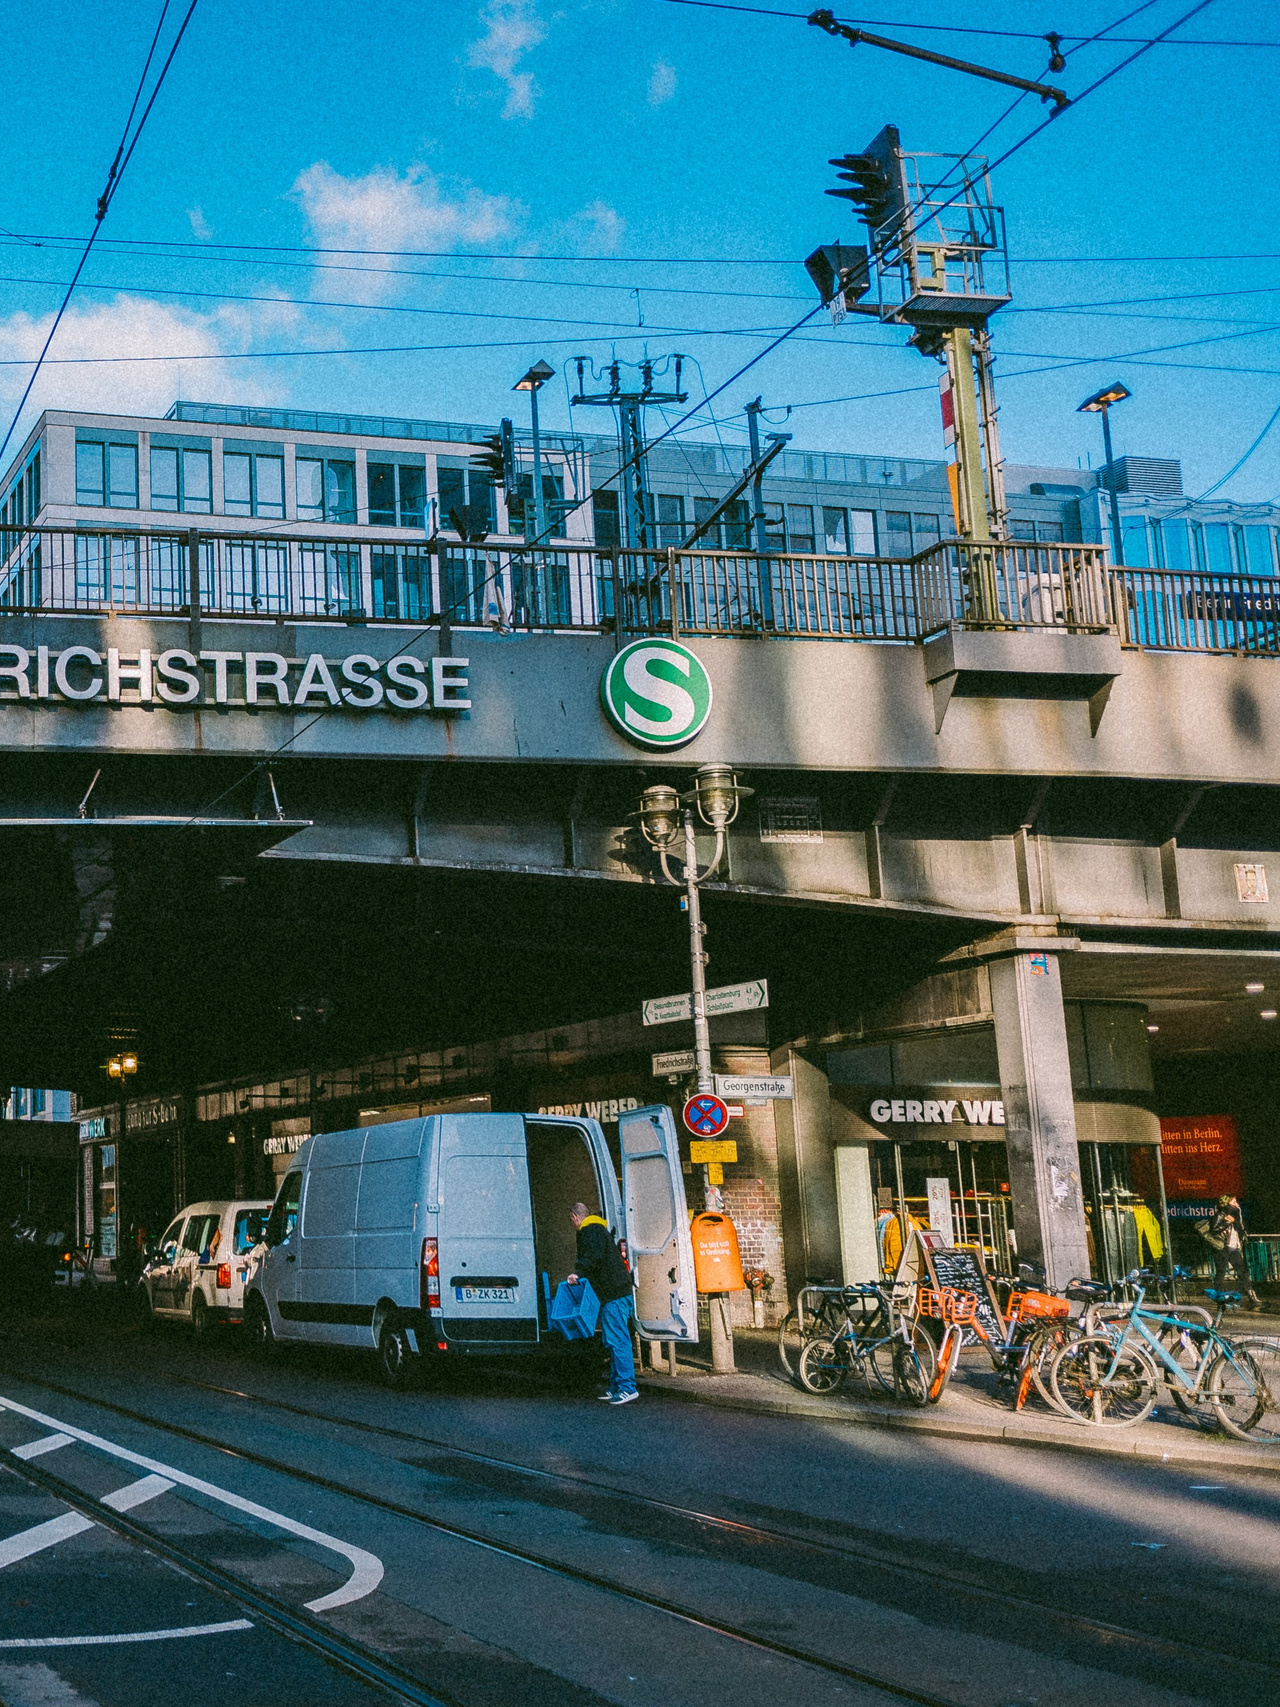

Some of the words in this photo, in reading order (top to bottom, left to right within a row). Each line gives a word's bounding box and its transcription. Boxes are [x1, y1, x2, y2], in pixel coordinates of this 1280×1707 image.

[623, 647, 696, 736] S
[706, 989, 741, 1002] Charlottenburg
[656, 1053, 695, 1069] Friedrichstraße
[723, 1079, 786, 1094] Georgenstraße
[870, 1099, 957, 1123] GERRY
[1162, 1129, 1181, 1140] itten
[1183, 1130, 1192, 1139] in
[1194, 1127, 1223, 1139] Berlin.
[263, 1136, 286, 1155] GERRY
[1161, 1143, 1183, 1154] itten
[1185, 1143, 1198, 1153] ins
[1200, 1141, 1224, 1152] Herz.
[1166, 1205, 1218, 1217] edrichstra
[465, 1289, 472, 1299] B
[478, 1289, 490, 1299] ZK
[492, 1289, 509, 1299] 321
